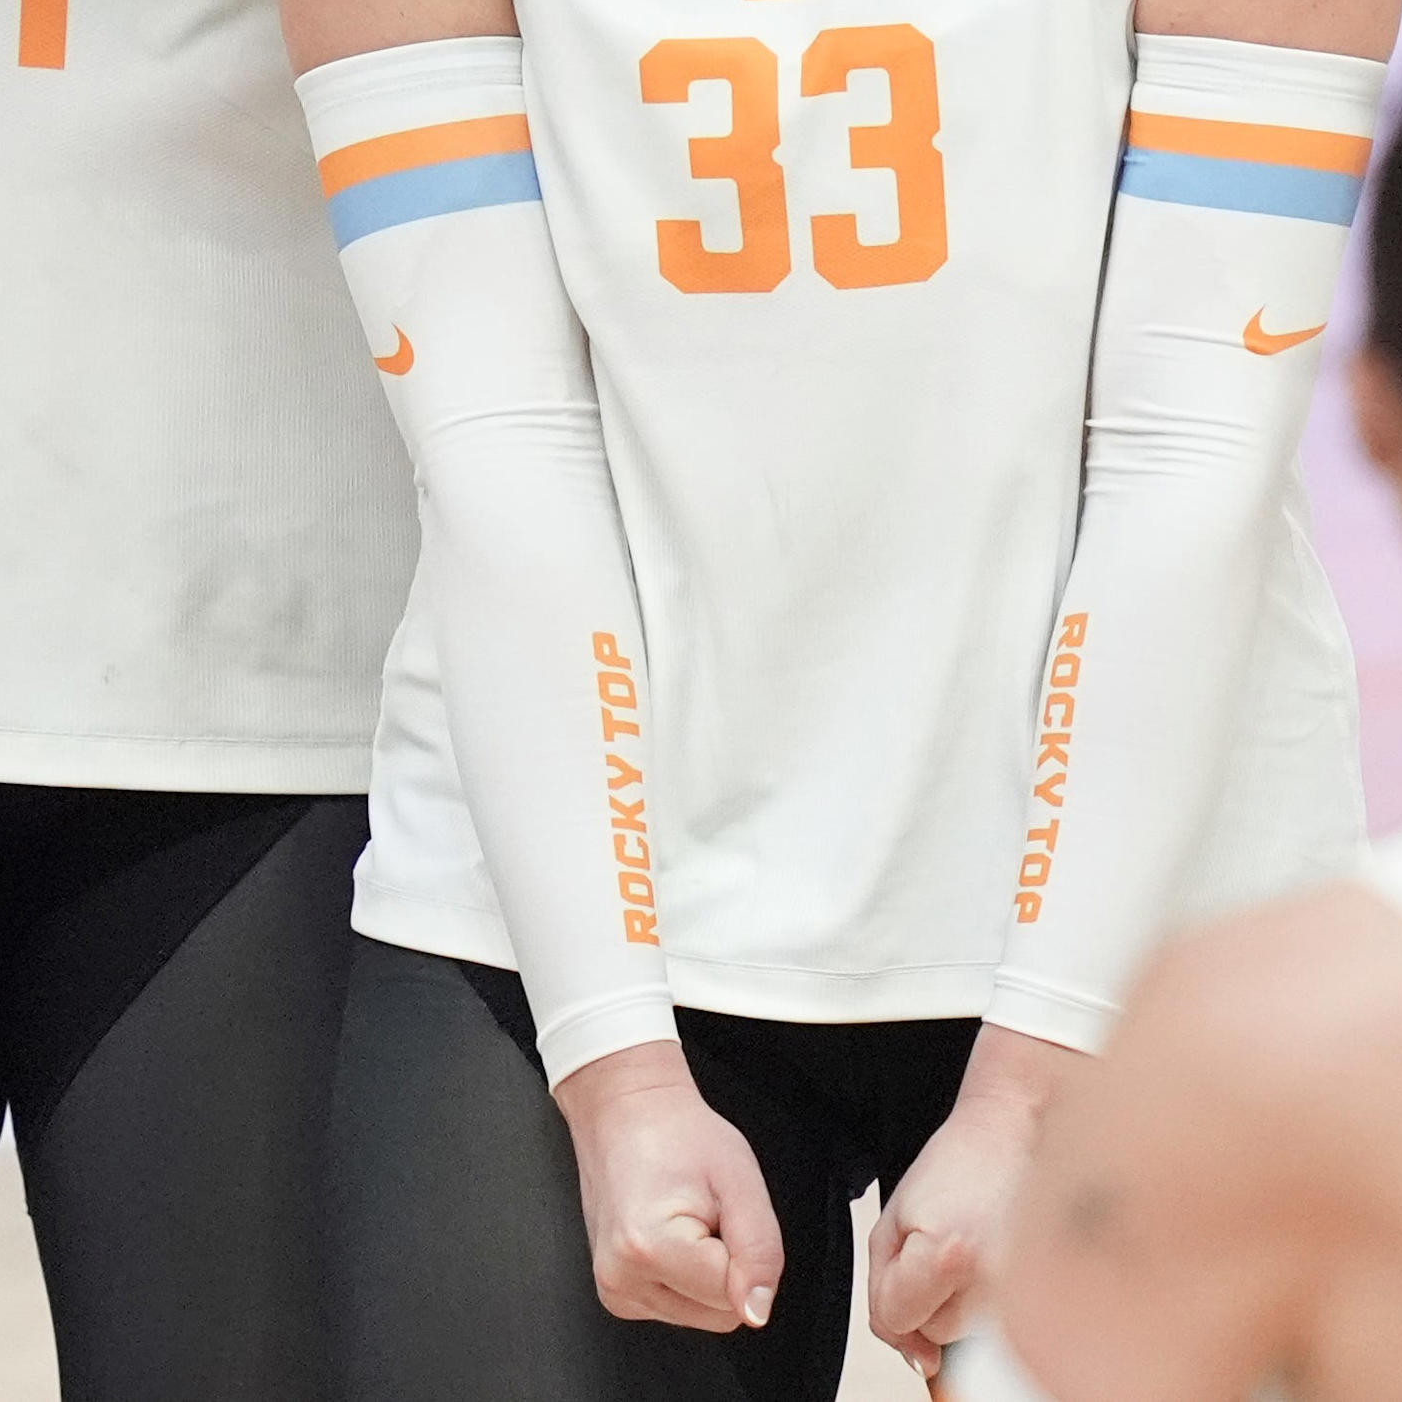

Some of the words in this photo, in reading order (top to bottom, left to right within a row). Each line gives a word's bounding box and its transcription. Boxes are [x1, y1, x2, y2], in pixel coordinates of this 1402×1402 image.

[639, 23, 949, 295] 33
[592, 631, 641, 743] TOP
[1035, 613, 1089, 807] ROCKY
[605, 753, 660, 946] ROCKY
[1014, 818, 1060, 923] TOP
